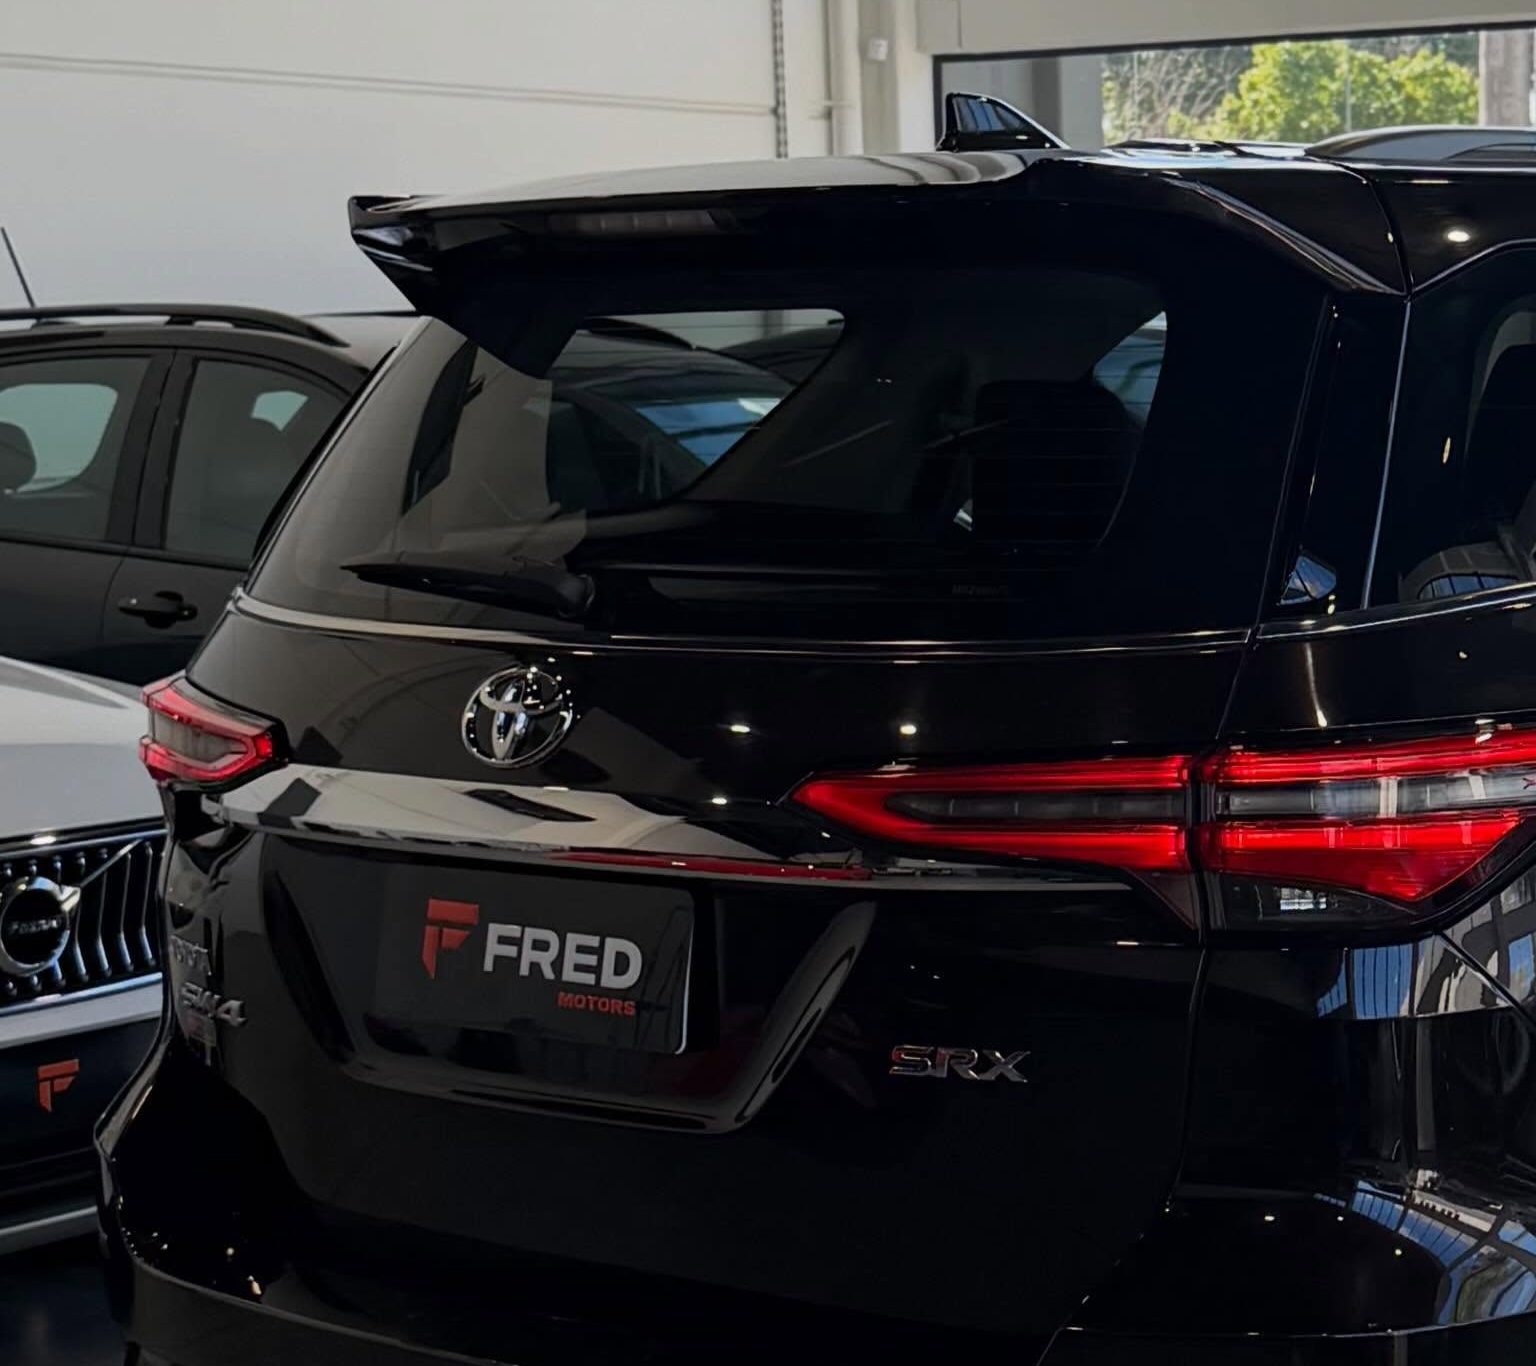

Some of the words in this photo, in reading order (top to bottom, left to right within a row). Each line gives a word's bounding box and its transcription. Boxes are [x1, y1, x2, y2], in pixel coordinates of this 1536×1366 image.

[483, 922, 643, 990] FRED
[557, 991, 637, 1017] MOTORS
[889, 1043, 1031, 1083] SRX
